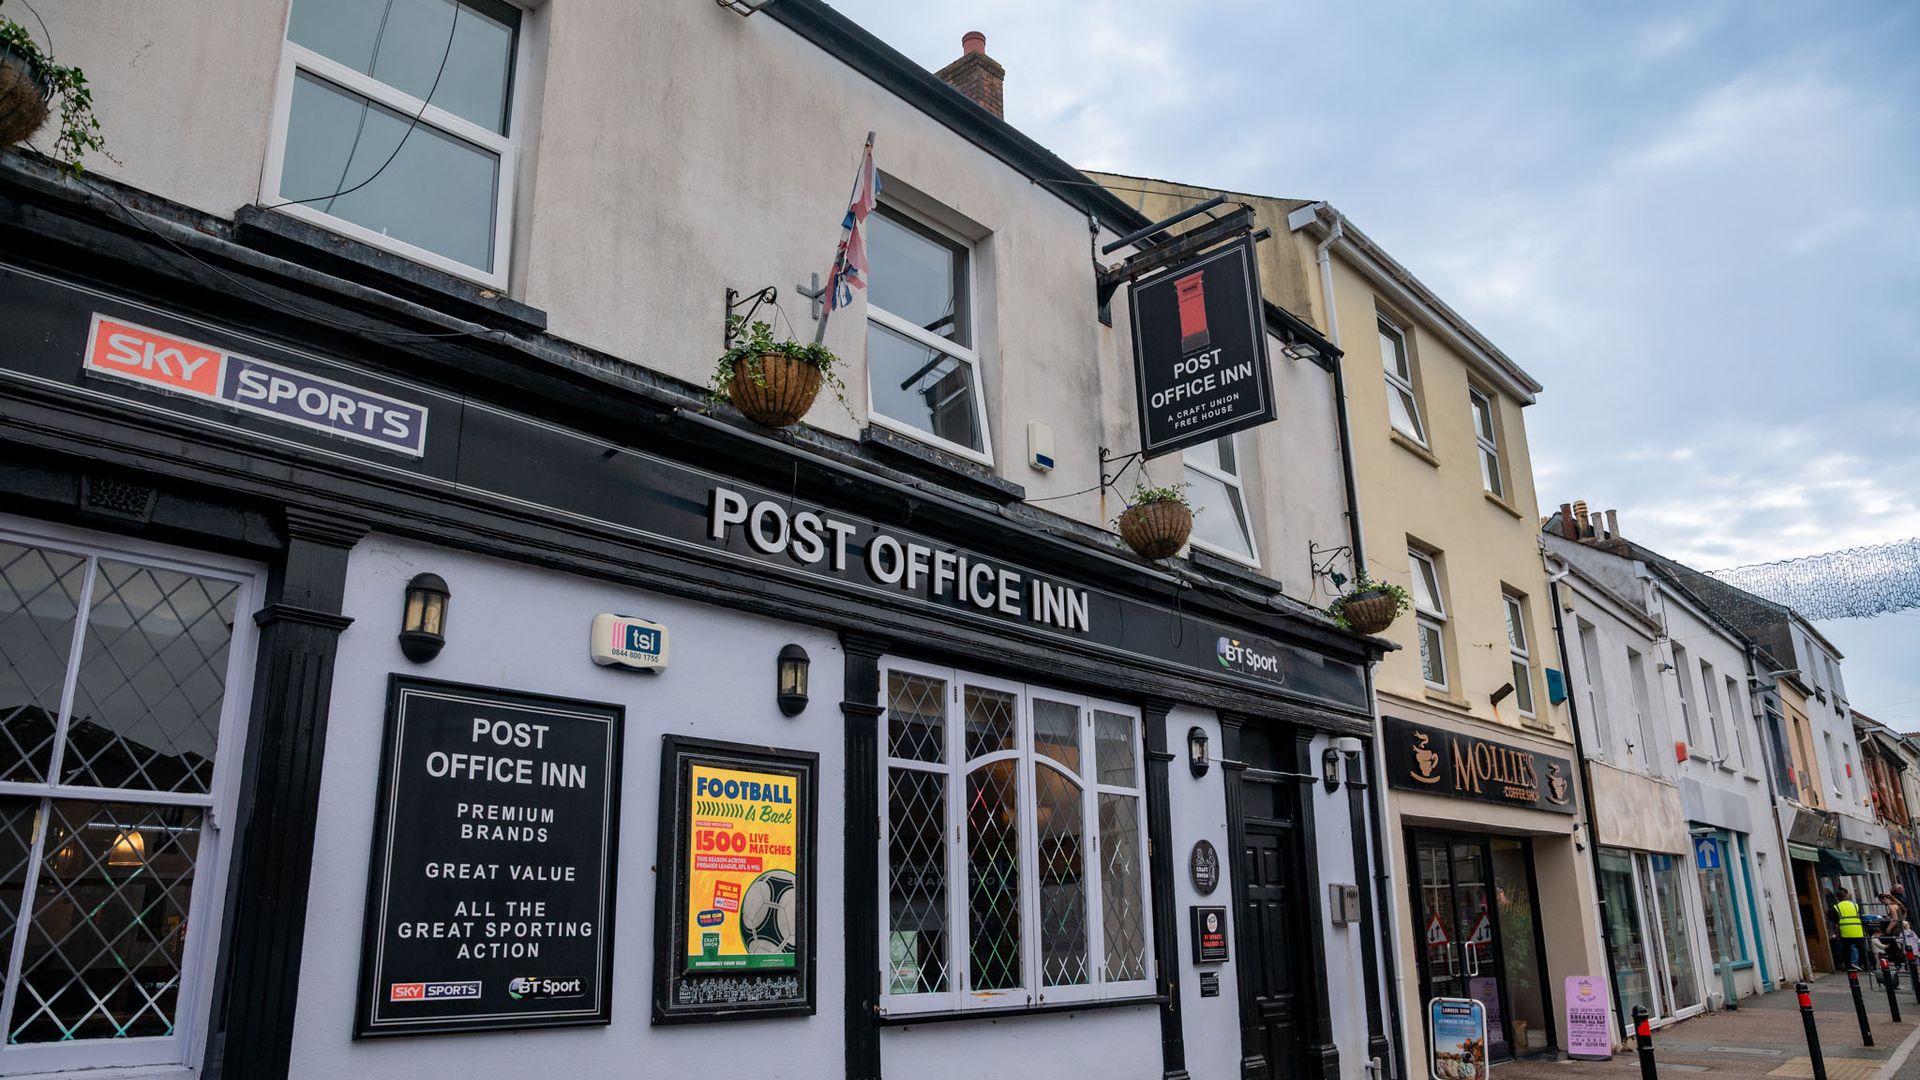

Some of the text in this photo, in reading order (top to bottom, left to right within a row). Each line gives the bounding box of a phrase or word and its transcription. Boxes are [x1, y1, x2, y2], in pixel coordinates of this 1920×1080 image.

[1173, 348, 1222, 379] POST
[106, 333, 410, 438] SKY SPORTS
[1151, 361, 1252, 408] OFFICE INN
[1176, 403, 1206, 419] CRAFT
[1210, 392, 1240, 408] UNION
[1174, 404, 1233, 430] FREE HOUSE
[713, 487, 1089, 633] POST OFFICE INN
[633, 629, 655, 651] tsi
[612, 648, 659, 663] 0844 800 1755
[1225, 645, 1278, 673] BT Sport
[472, 718, 549, 749] POST
[426, 751, 586, 789] OFFICE INN
[697, 776, 792, 804] FOOTBALL
[457, 803, 554, 823] PREMIUM
[759, 805, 793, 824] Back
[461, 824, 548, 842] BRANDS
[695, 829, 746, 853] 1500
[749, 833, 769, 843] LIVE
[749, 844, 792, 855] MATCHES
[425, 863, 576, 881] GREAT VALUE
[454, 901, 546, 917] ALL THE
[398, 922, 592, 938] GREAT SPORTING
[456, 943, 539, 959] ACTION
[395, 985, 477, 998] SKY SPORTS
[518, 979, 580, 994] BT Sport
